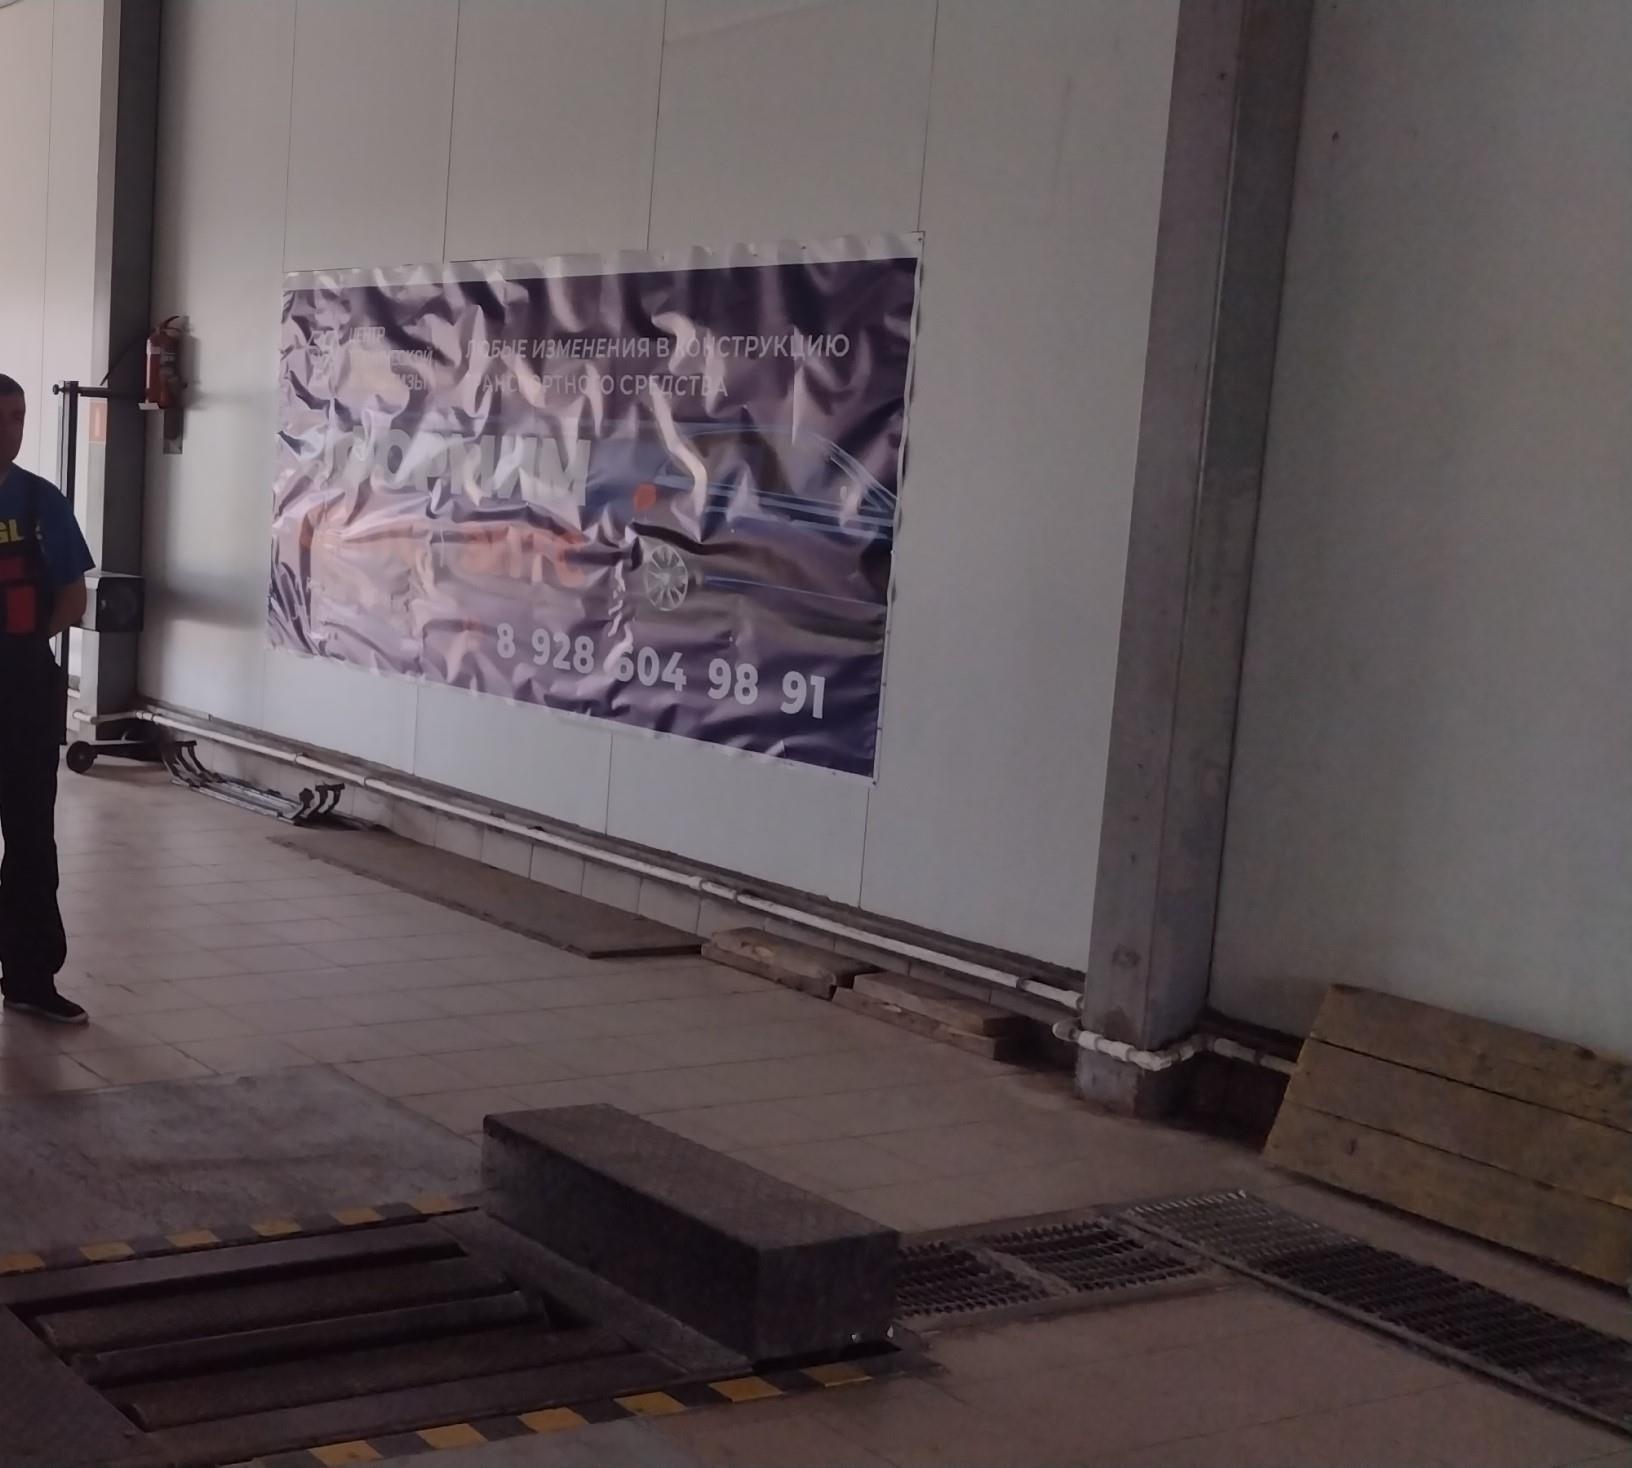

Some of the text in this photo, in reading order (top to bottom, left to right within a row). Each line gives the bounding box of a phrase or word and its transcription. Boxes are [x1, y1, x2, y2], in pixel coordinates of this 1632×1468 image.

[532, 336, 650, 359] ИЗМЕНЕНИЯ
[656, 337, 670, 358] В
[620, 374, 728, 397] СРЕДСТВА
[497, 623, 826, 719] 8 928 604 98 91
